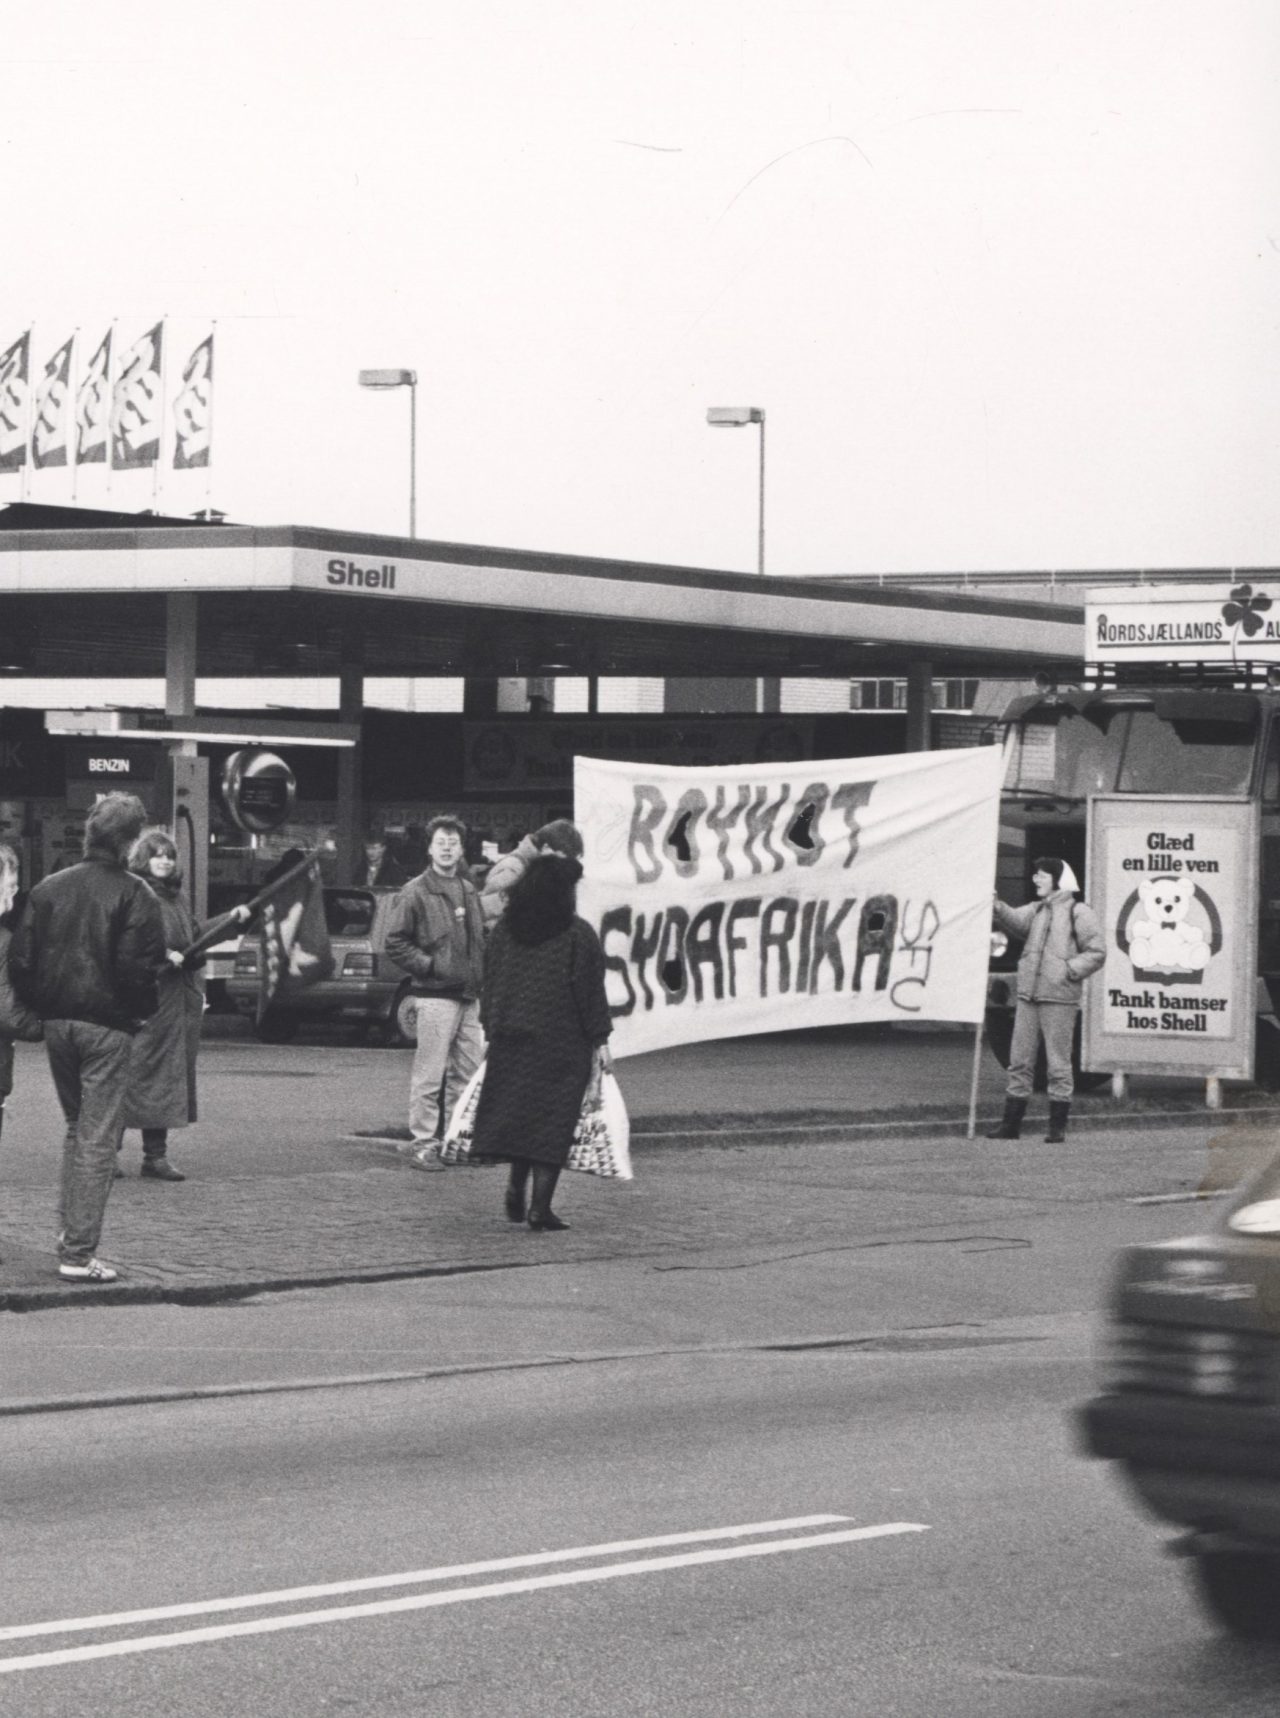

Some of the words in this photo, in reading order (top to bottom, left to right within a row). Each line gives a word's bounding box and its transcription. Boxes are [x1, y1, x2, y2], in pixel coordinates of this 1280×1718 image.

[327, 559, 396, 590] Shell
[1097, 621, 1223, 642] NORDSJÆLLANDS
[88, 758, 130, 772] BENZIN
[628, 780, 879, 884] BOYKOT
[1147, 832, 1195, 851] Glæd
[1122, 858, 1145, 871] en
[1147, 853, 1183, 872] lille
[1185, 859, 1219, 873] ven
[601, 894, 899, 1019] SYDAFRIKA
[1108, 989, 1155, 1009] Tank
[1158, 991, 1228, 1012] bamser
[1126, 1011, 1158, 1029] hos
[1161, 1012, 1207, 1032] Shell
